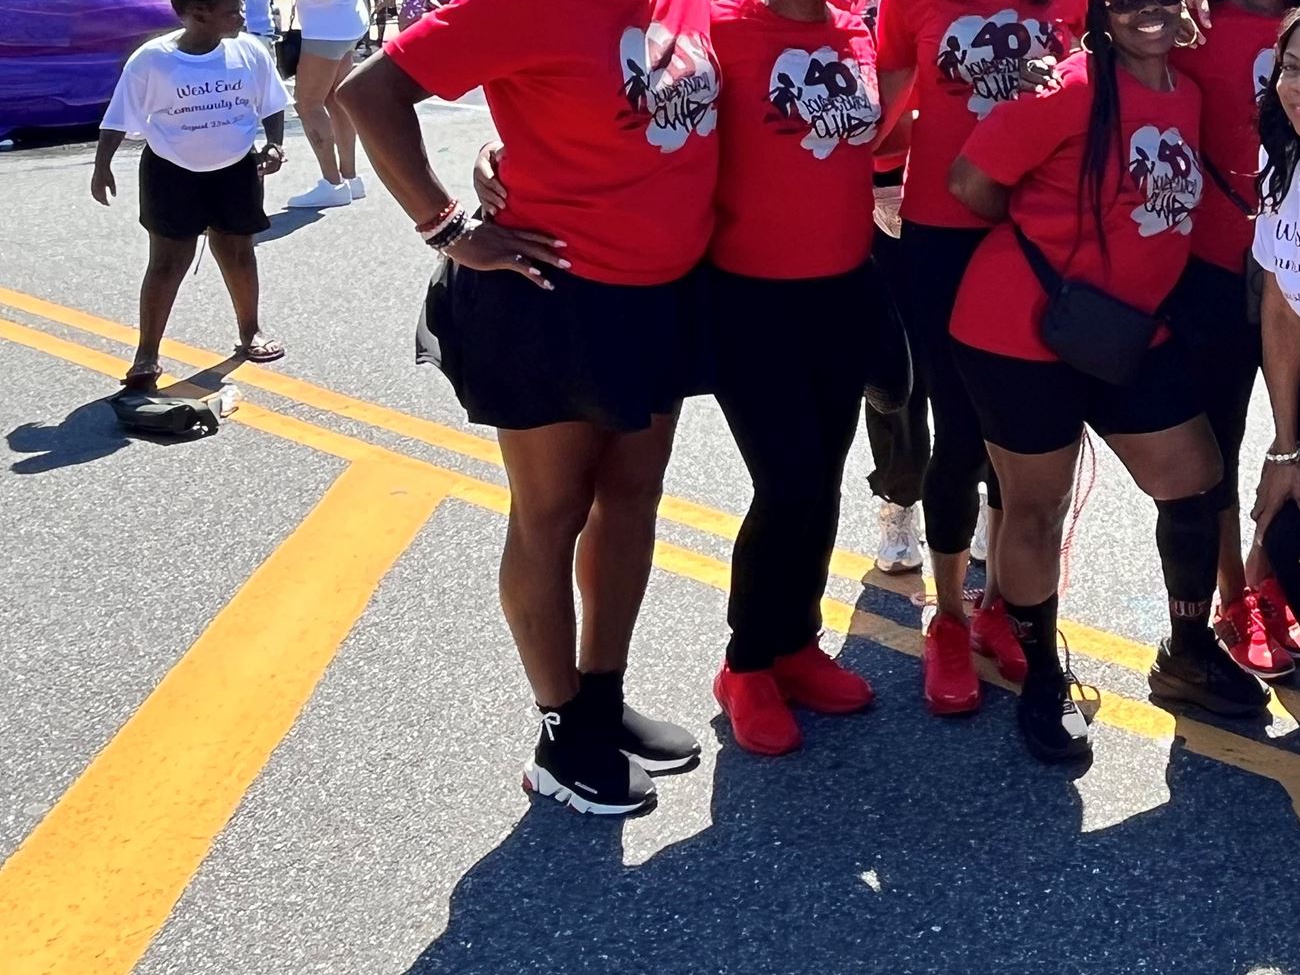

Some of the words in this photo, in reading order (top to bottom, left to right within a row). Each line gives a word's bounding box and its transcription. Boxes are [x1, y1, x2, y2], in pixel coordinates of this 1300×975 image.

[971, 21, 1032, 60] 40
[176, 82, 213, 99] West
[215, 79, 244, 93] End
[804, 58, 858, 98] 40
